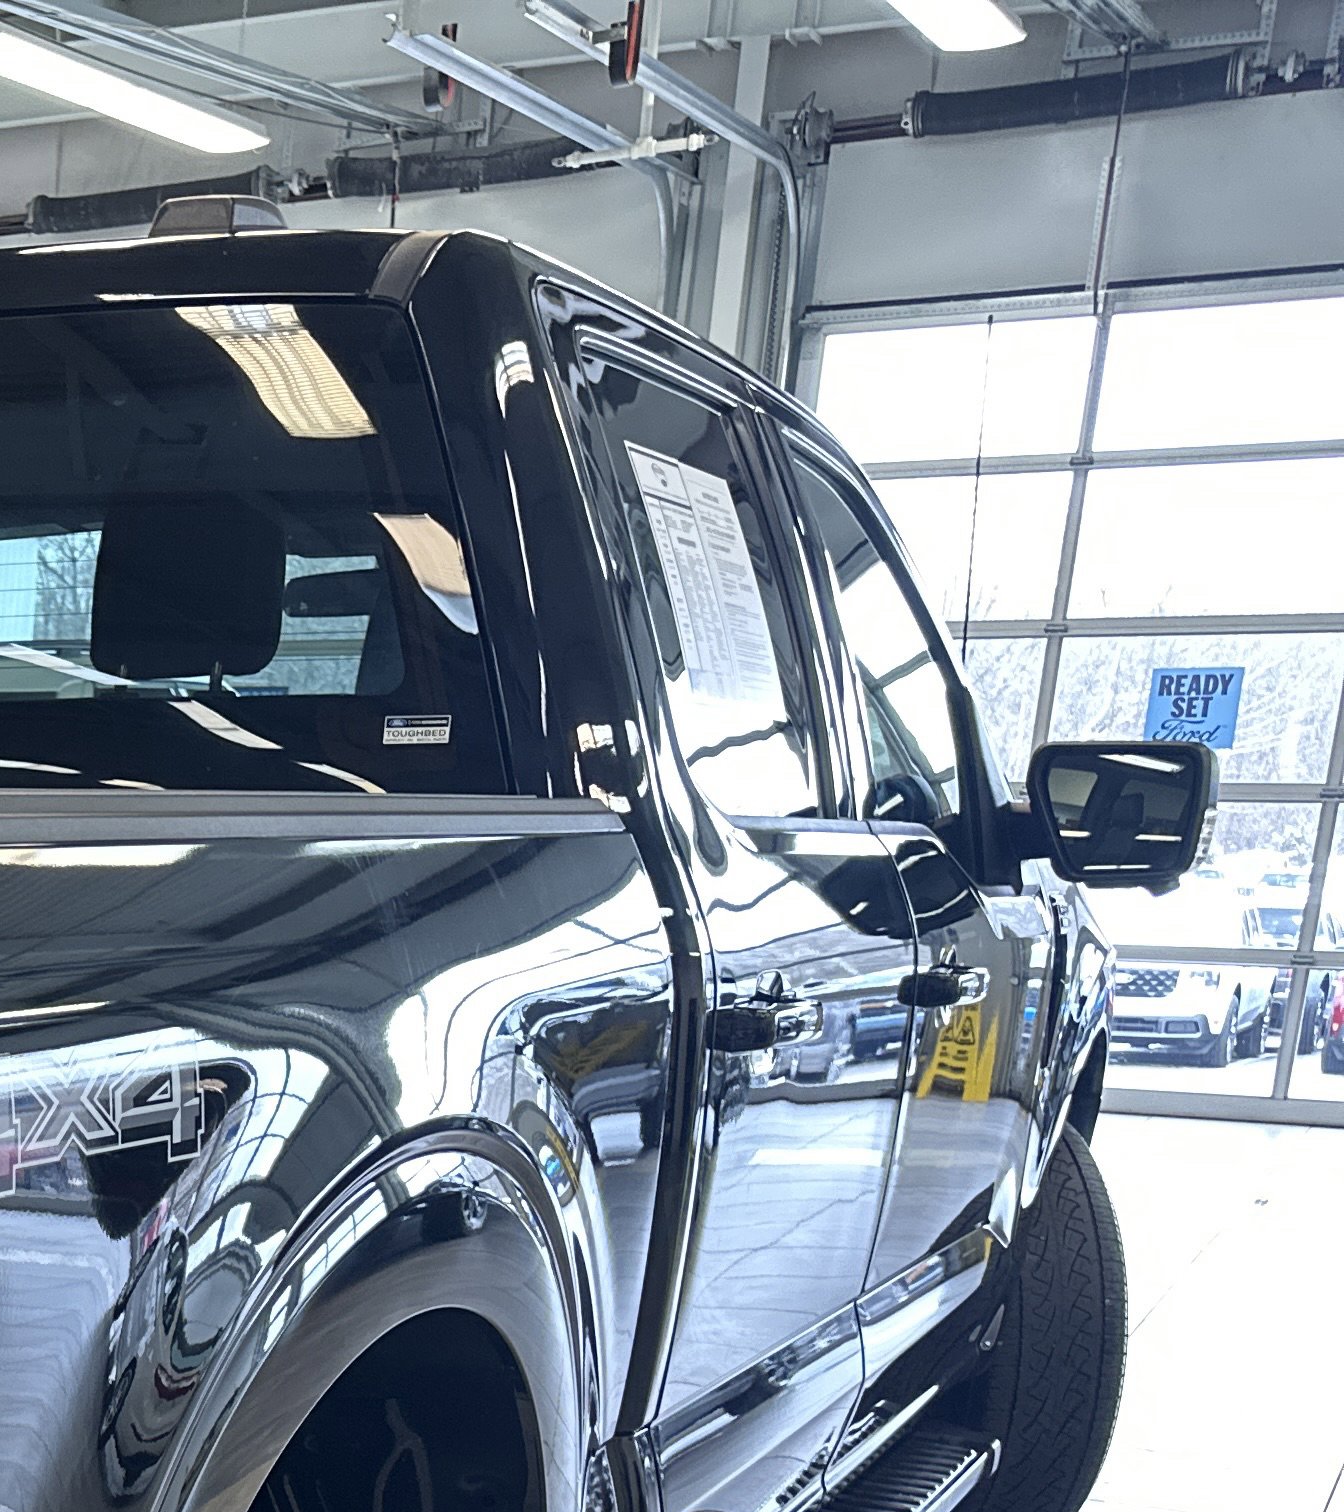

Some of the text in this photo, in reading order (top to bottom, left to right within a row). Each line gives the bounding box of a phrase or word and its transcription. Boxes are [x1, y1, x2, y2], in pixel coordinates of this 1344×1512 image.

[1158, 673, 1234, 696] READY
[1170, 696, 1214, 718] SET
[386, 729, 447, 738] TOUGHBED
[1152, 718, 1221, 742] Ford
